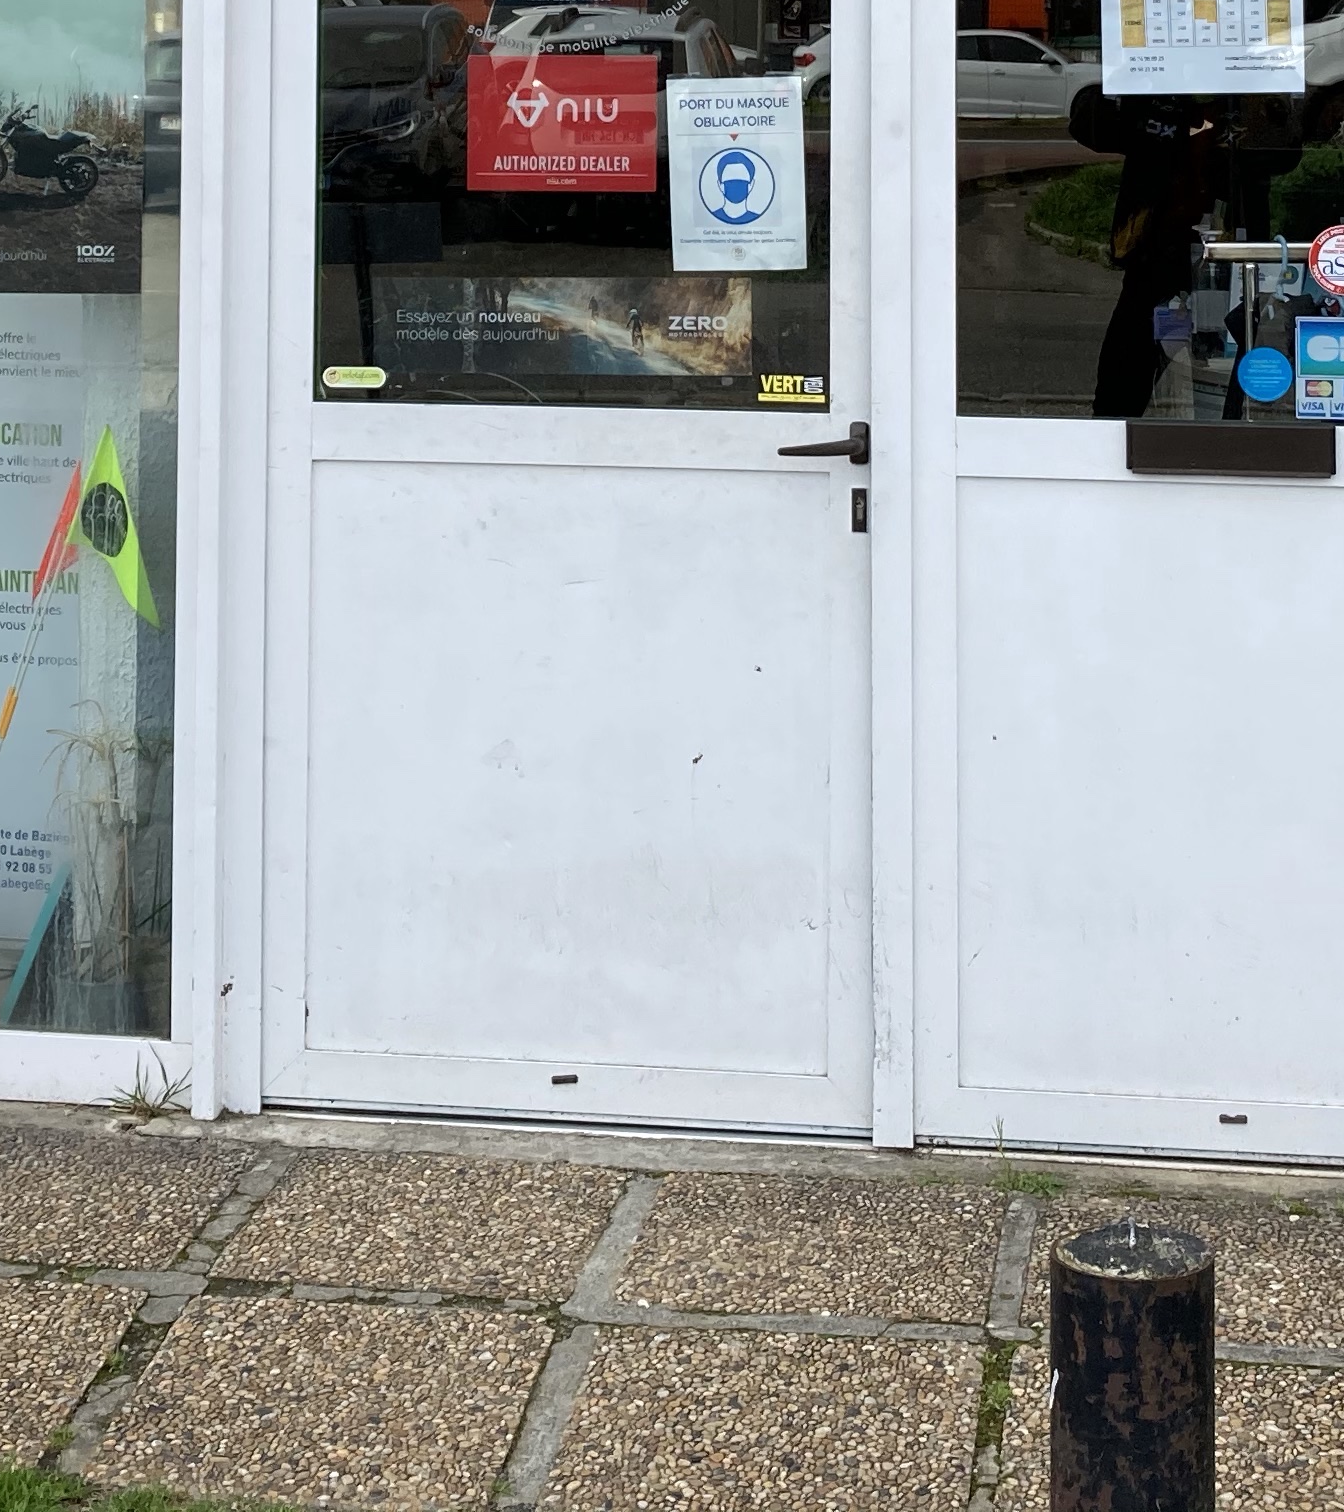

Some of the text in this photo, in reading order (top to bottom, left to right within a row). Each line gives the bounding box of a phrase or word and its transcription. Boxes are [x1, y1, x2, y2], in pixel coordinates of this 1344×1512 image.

[559, 34, 617, 53] mobilité
[679, 97, 790, 110] PORT DU MASQUE
[693, 115, 776, 128] OBLIGATOIRE
[493, 155, 630, 172] AUTHORIZED DEALER
[76, 245, 115, 258] 100%
[396, 309, 541, 327] Essayez un nouveau
[668, 315, 728, 331] ZERO
[396, 327, 560, 344] modèle dès aujourd'hui
[760, 374, 805, 393] VERT
[1300, 401, 1325, 412] VISA
[62, 456, 77, 469] de
[14, 829, 29, 841] de
[5, 860, 19, 872] 92
[21, 862, 35, 873] 08
